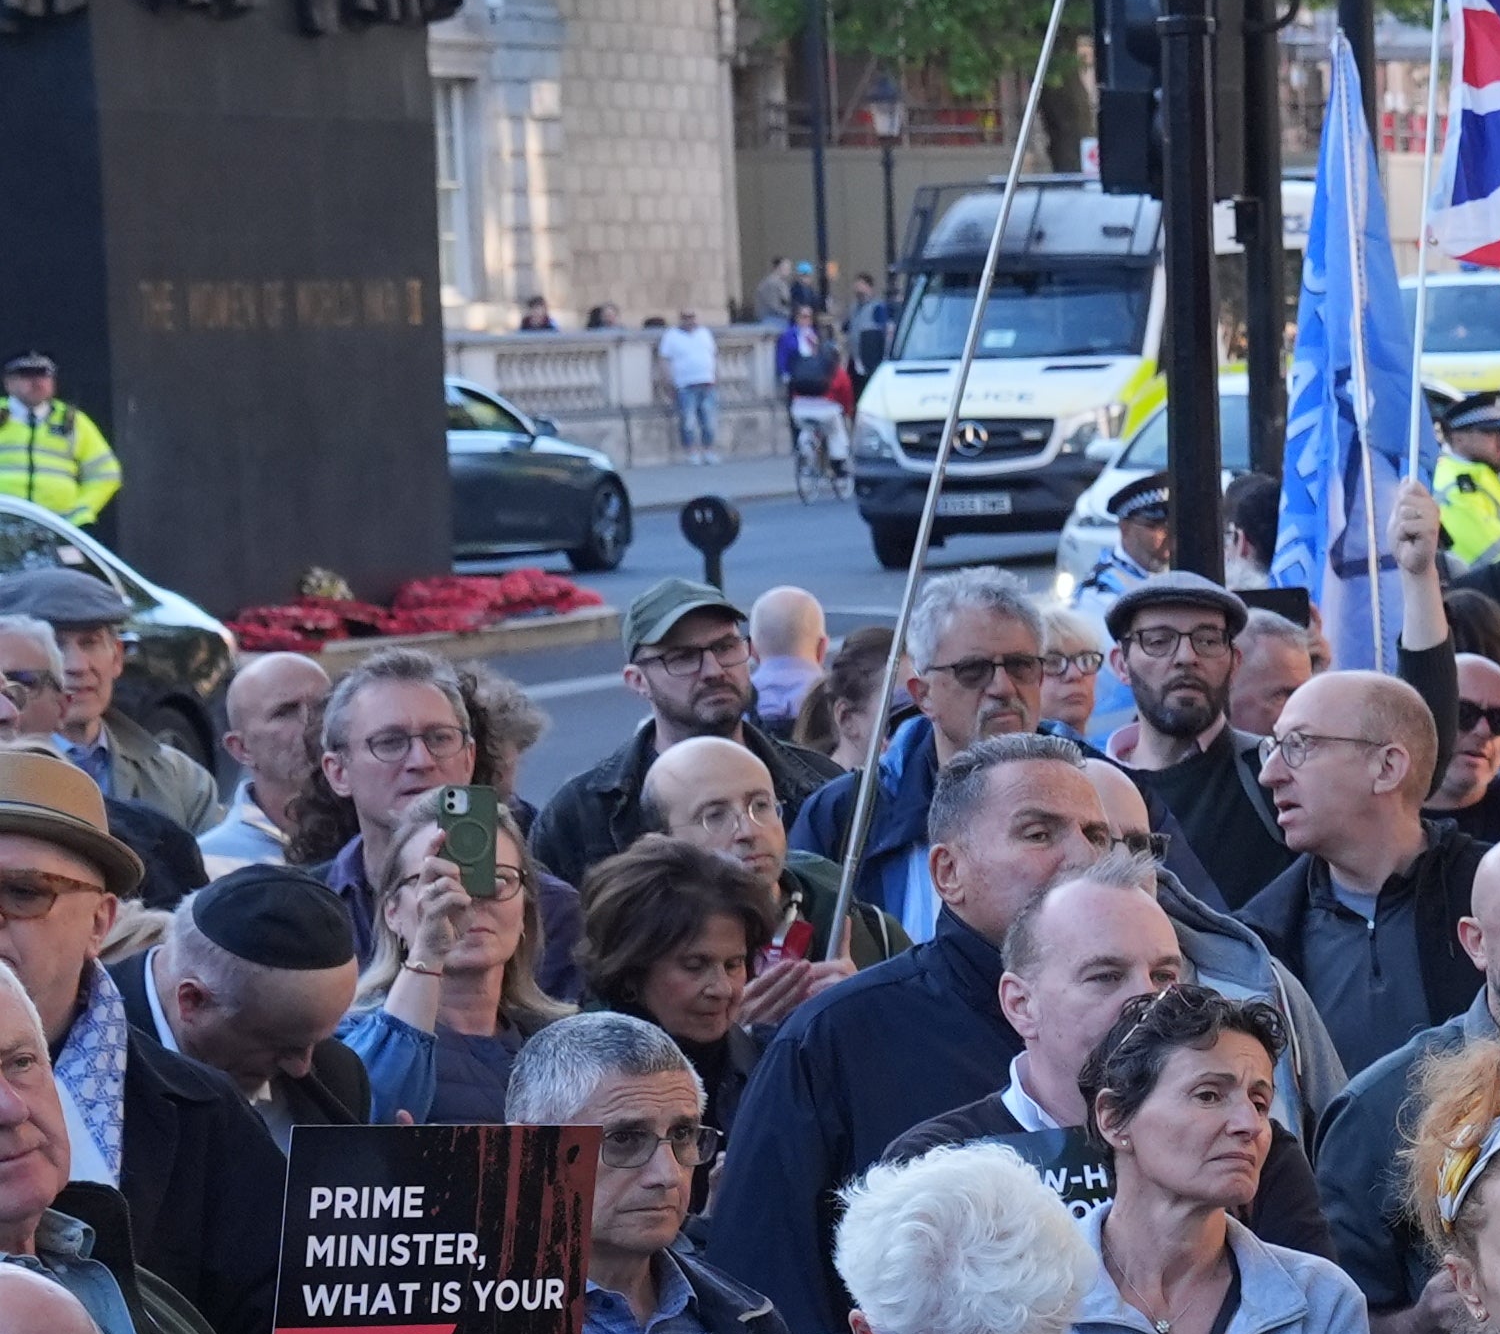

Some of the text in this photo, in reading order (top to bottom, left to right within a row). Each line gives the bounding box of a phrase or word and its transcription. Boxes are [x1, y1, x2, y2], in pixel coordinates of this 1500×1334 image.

[309, 1185, 425, 1220] PRIME
[305, 1233, 487, 1271] MINISTER,
[302, 1278, 565, 1317] WHAT IS YOUR
